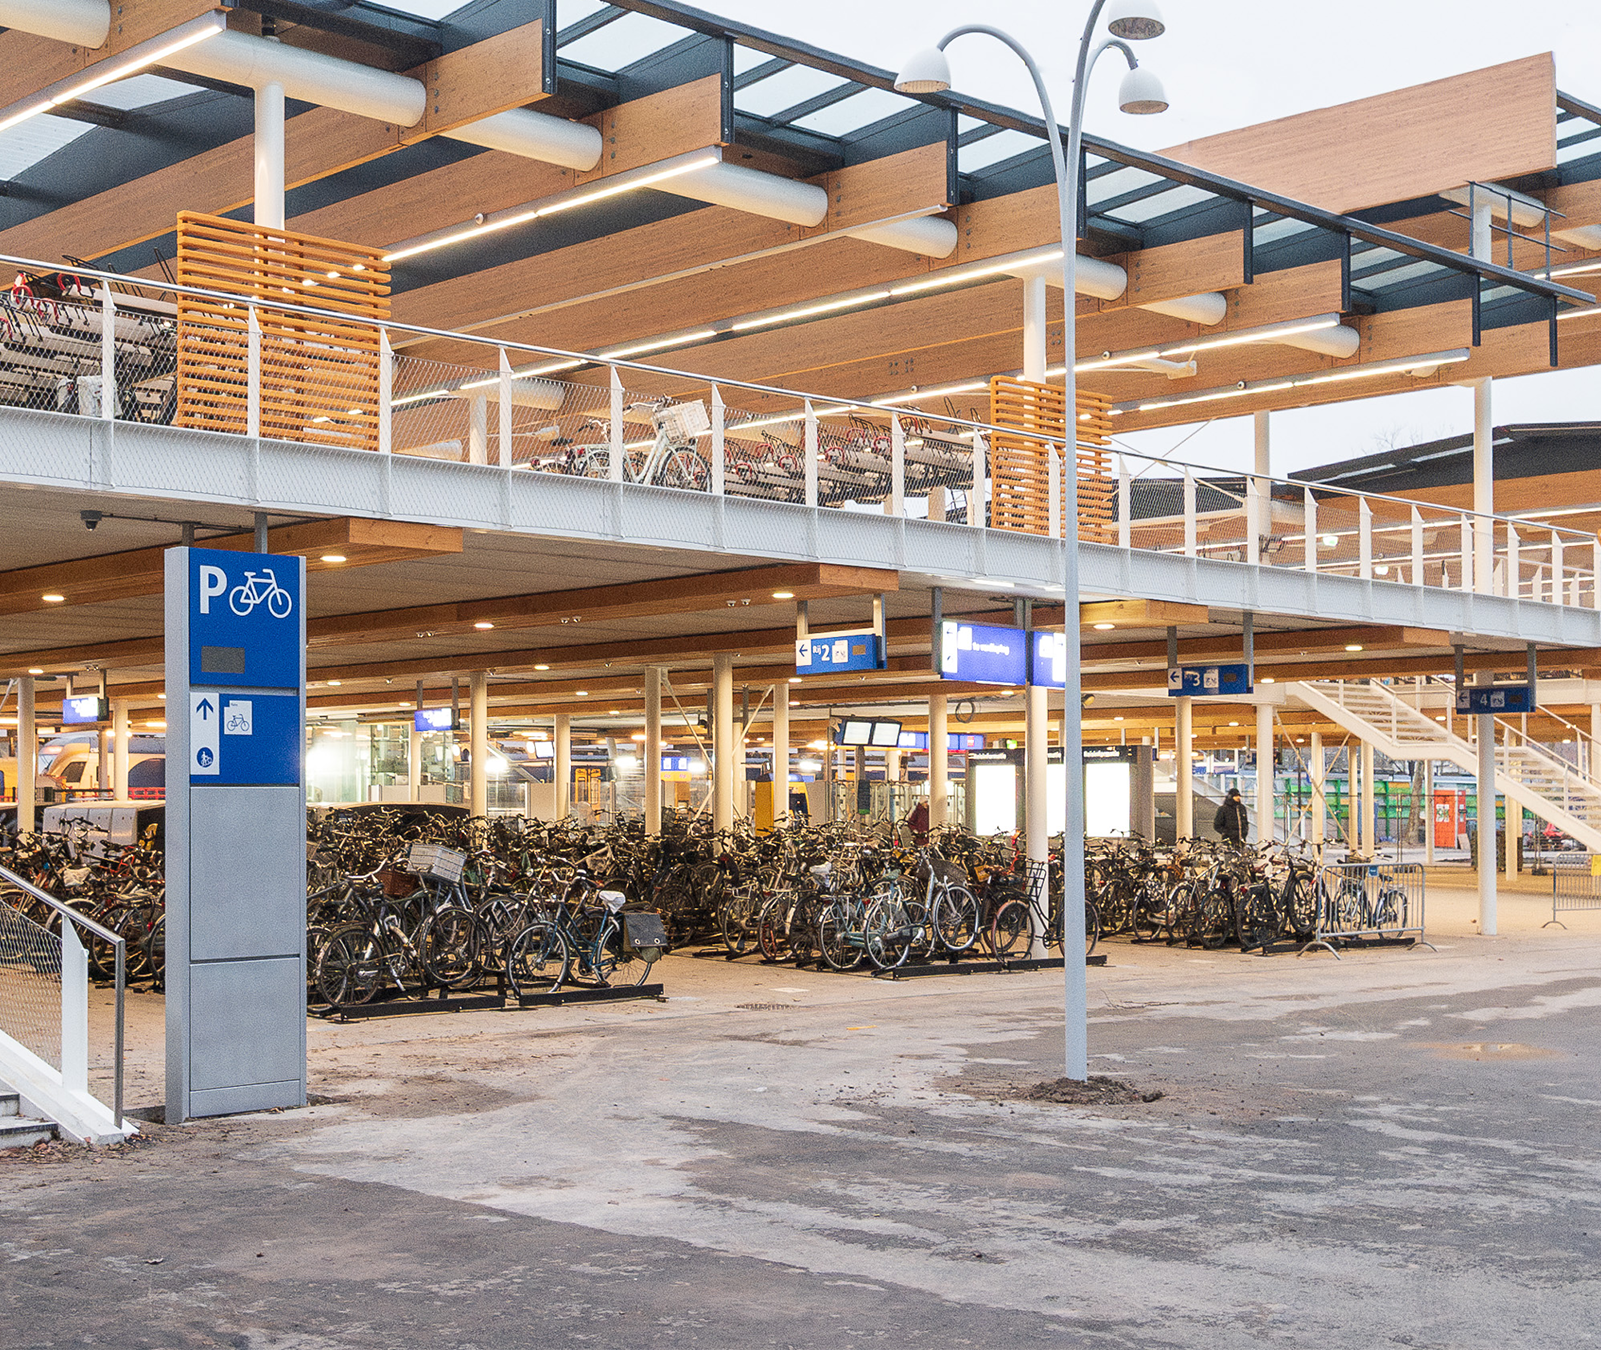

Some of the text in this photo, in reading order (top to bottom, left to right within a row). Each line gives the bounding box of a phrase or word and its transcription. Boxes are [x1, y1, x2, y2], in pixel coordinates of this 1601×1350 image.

[199, 564, 228, 614] P
[812, 644, 830, 661] Rij 2
[1193, 672, 1201, 687] 3
[1480, 693, 1488, 706] 4
